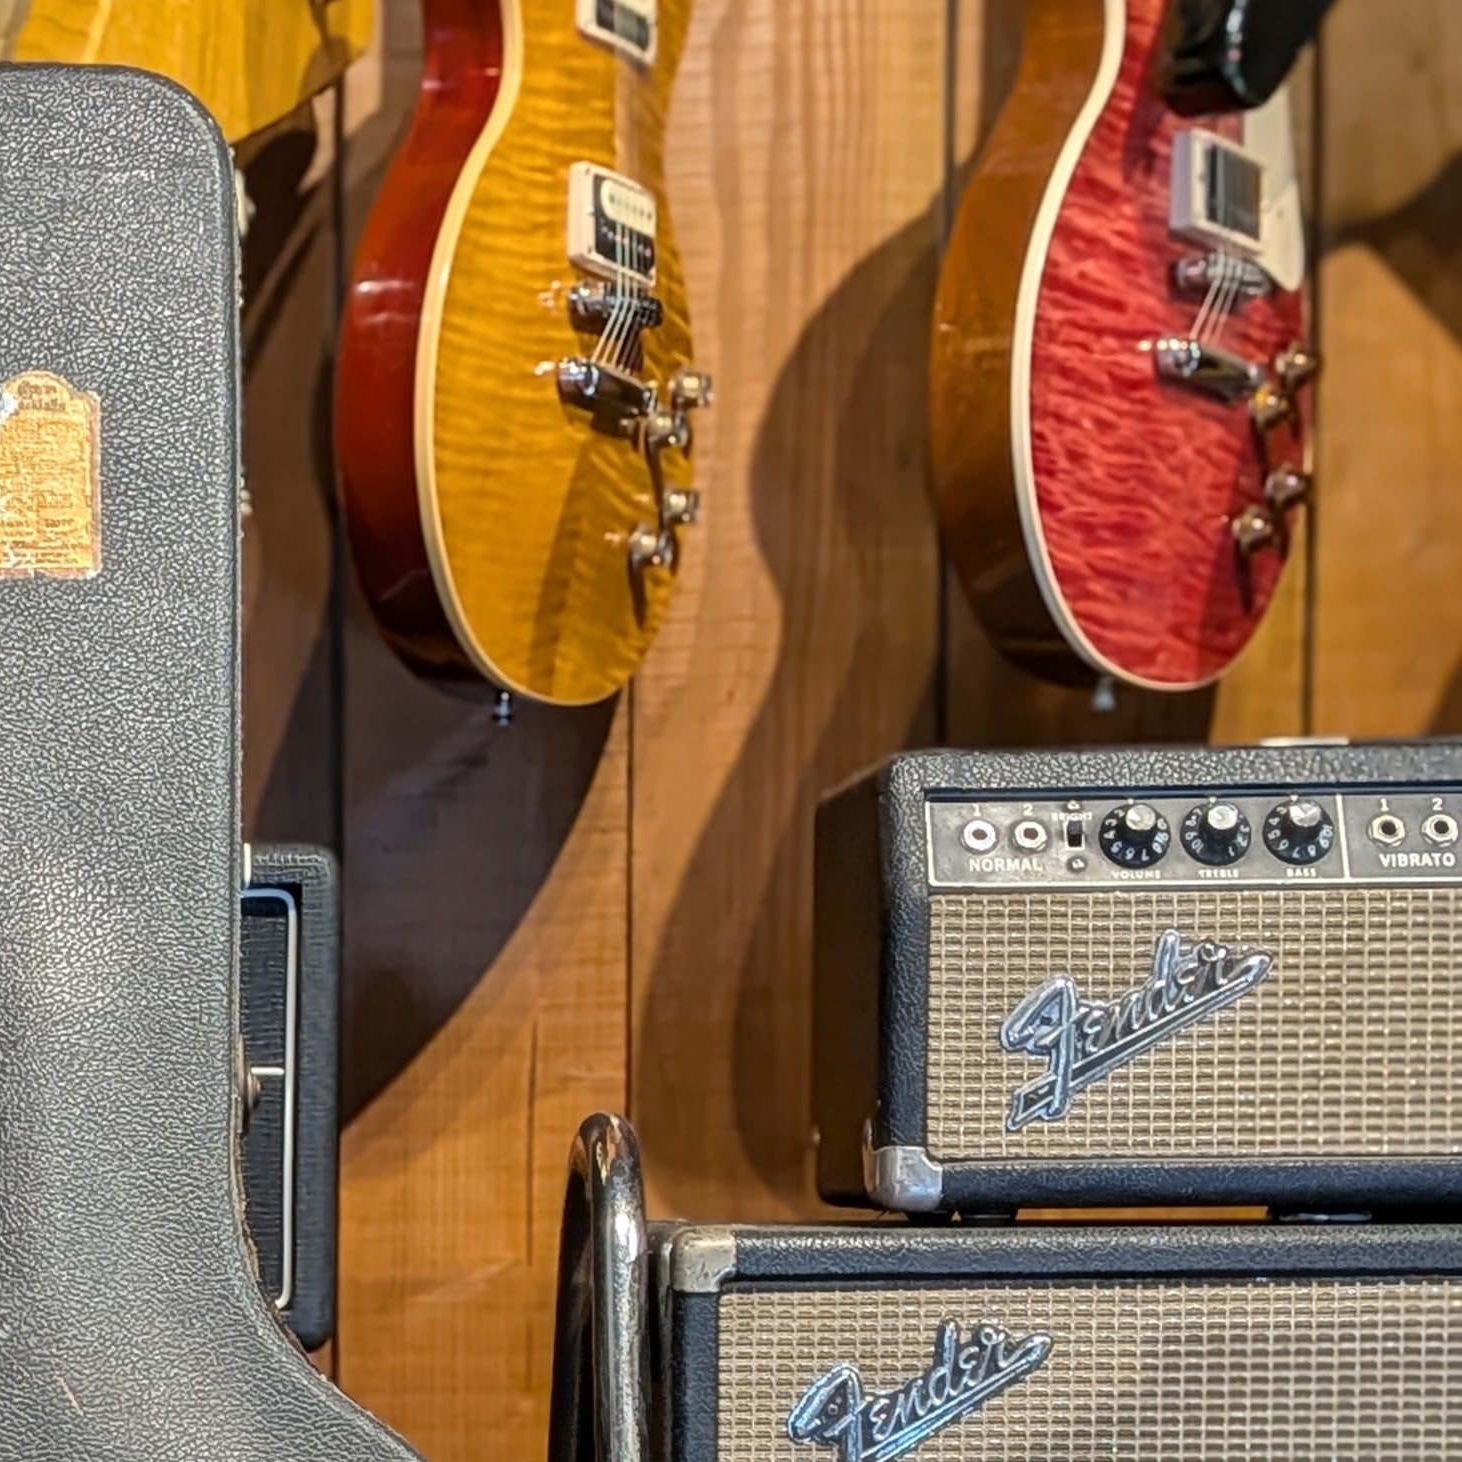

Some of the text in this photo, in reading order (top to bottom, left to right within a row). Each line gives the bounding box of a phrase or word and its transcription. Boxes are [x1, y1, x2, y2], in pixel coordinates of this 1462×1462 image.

[972, 803, 981, 817] 1
[1022, 802, 1033, 817] 2
[1379, 798, 1389, 811] 1
[1432, 797, 1443, 811] 2
[969, 858, 1043, 872] NORMAL
[1378, 853, 1456, 867] VIBRATO
[1111, 869, 1162, 879] VOLUME
[1198, 868, 1239, 878] TREBLE
[1286, 867, 1317, 877] BASS
[1000, 928, 1273, 1131] Fender
